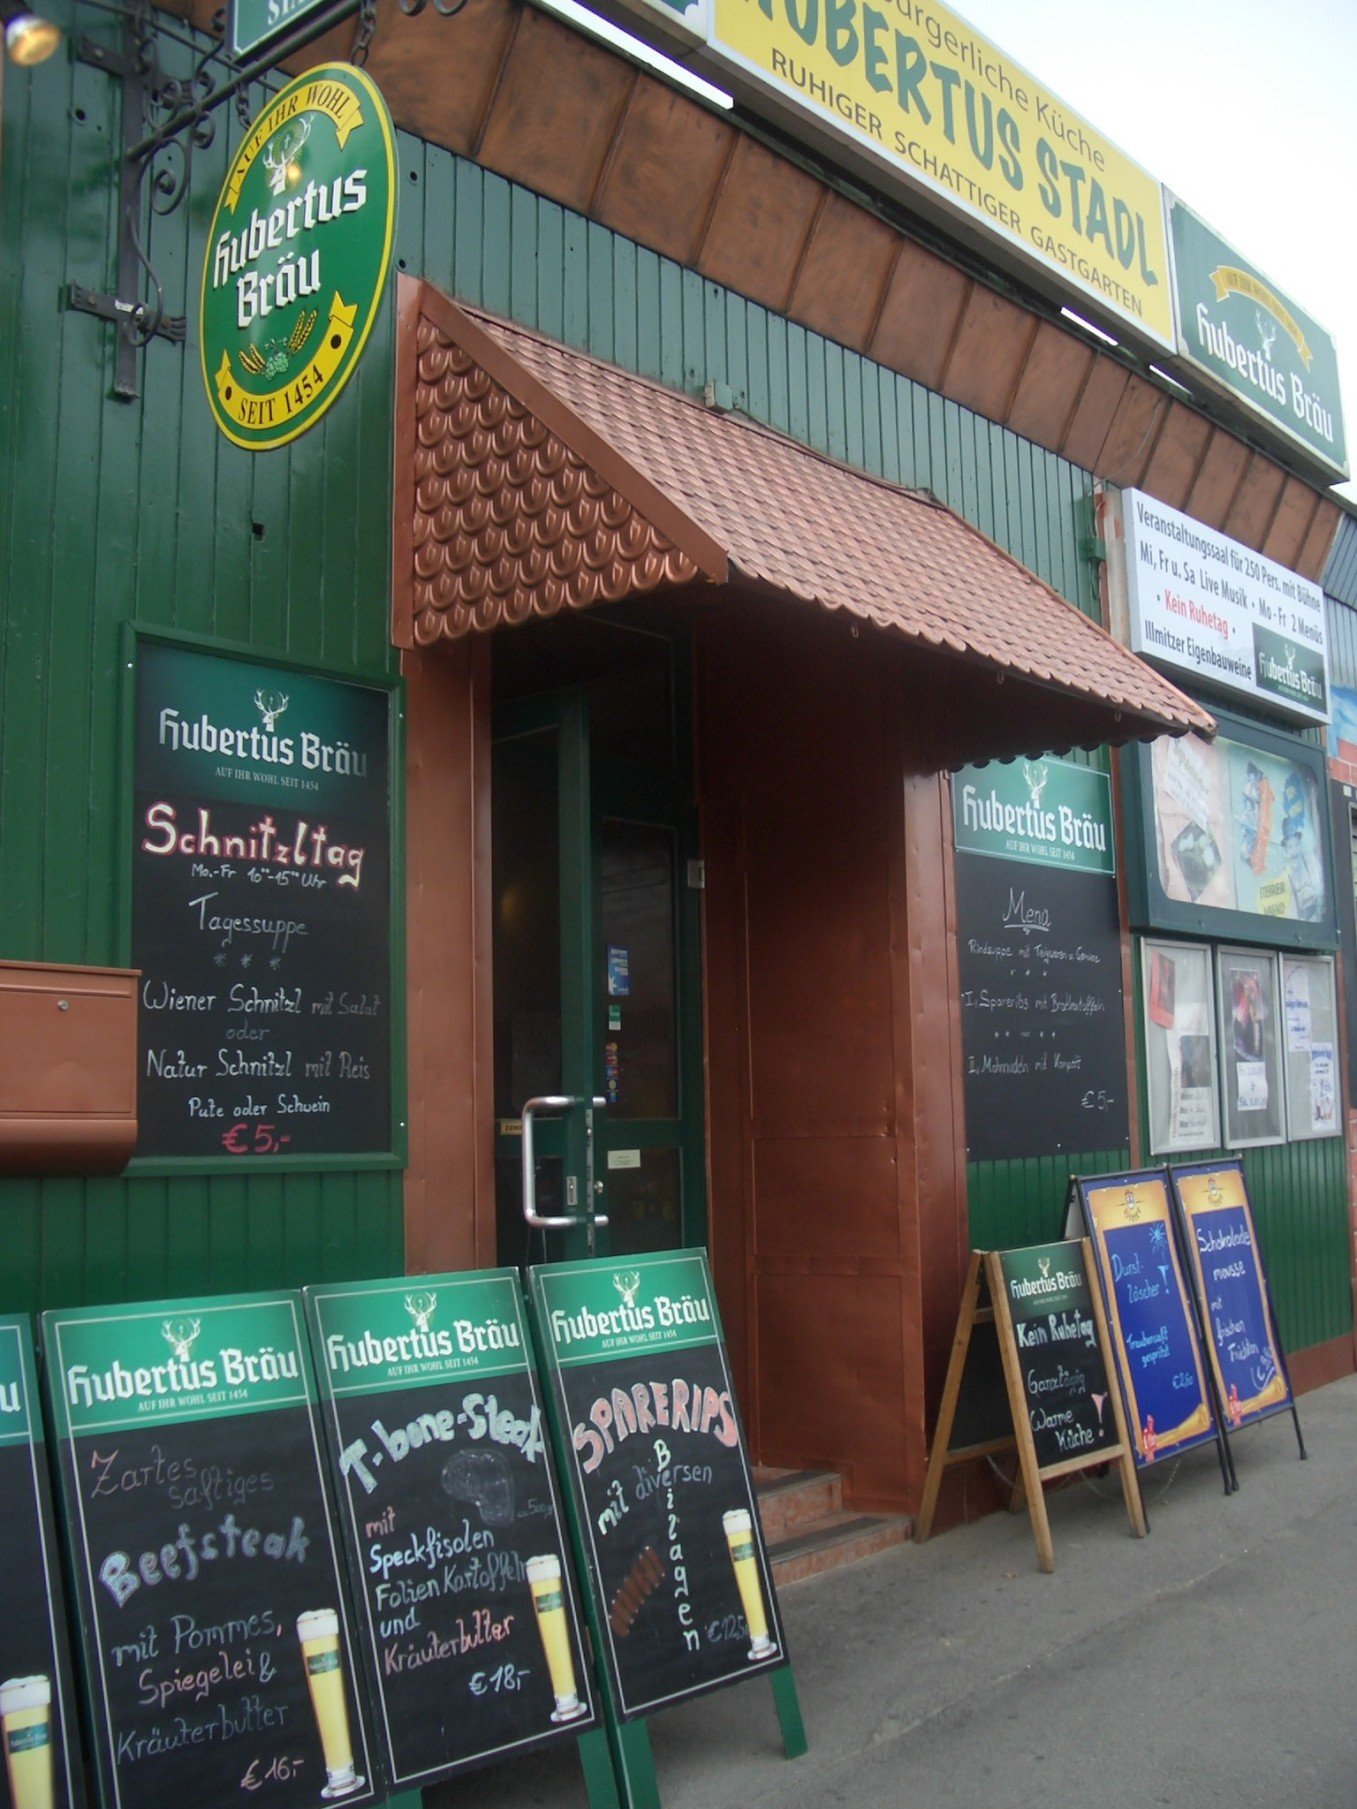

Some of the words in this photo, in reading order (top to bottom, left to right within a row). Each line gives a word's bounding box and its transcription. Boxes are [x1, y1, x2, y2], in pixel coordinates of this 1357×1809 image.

[268, 95, 299, 132] IHR
[306, 83, 351, 119] WOHL
[1035, 96, 1105, 172] Küche
[745, 0, 1024, 192] UBERTUS
[1036, 137, 1158, 287] STADL
[772, 48, 882, 141] RUHIGER
[894, 131, 1021, 234] SCHATTIGER
[1031, 226, 1143, 318] GASTGARTEN
[213, 169, 368, 290] Hubertus
[236, 249, 321, 330] Bräu
[238, 397, 276, 424] SEIT
[283, 364, 324, 415] 1454
[1196, 303, 1287, 406] Hubertus
[1290, 372, 1334, 443] Bräu
[1137, 501, 1228, 565] Veranstaltungssaal
[1230, 549, 1244, 571] für
[1245, 556, 1260, 581] 250
[1262, 568, 1281, 592] Pers.
[1282, 582, 1296, 599] mit
[1297, 585, 1321, 613] Bühne
[1140, 540, 1156, 571] Mi,
[1159, 550, 1169, 570] Fr
[1184, 561, 1196, 585] Sa
[1200, 569, 1220, 596] Live
[1221, 580, 1249, 609] Musik
[1259, 597, 1272, 618] Mo
[1298, 615, 1323, 645] Menüs
[1165, 589, 1187, 617] Kein
[1189, 604, 1229, 640] Ruhetag
[1145, 619, 1185, 654] Illmitzer
[1187, 636, 1252, 681] Eigenbauweine
[158, 707, 294, 766] Hubertus
[300, 732, 368, 778] Bräu
[215, 766, 233, 778] AUF
[234, 769, 251, 781] IHR
[253, 771, 279, 786] WOHL
[280, 776, 300, 789] SEIT
[301, 779, 319, 791] 1454
[142, 801, 365, 891] Schnitzltag
[963, 784, 1057, 842] Hubertus
[1058, 805, 1107, 852] Bräu
[301, 872, 328, 889] Uhr
[189, 891, 309, 953] Tagessuppe
[143, 980, 217, 1012] Wiener
[227, 983, 302, 1015] Schnitzl
[311, 991, 333, 1015] mit
[225, 1021, 271, 1041] oder
[146, 1049, 208, 1079] Natur
[216, 1048, 292, 1077] Schnitzl
[305, 1051, 332, 1078] mit
[339, 1051, 371, 1080] Reis
[188, 1096, 225, 1118] Pute
[233, 1095, 267, 1118] oder
[277, 1093, 331, 1115] Schwein
[1010, 1275, 1057, 1300] Hubertus
[1056, 1271, 1083, 1293] Bräu
[327, 1329, 453, 1373] Hubertus
[453, 1318, 521, 1354] Bräu
[551, 1304, 655, 1344] Hubertus
[654, 1295, 711, 1327] Bräu
[1016, 1322, 1049, 1348] Kein
[1048, 1309, 1098, 1349] Ruhetag
[67, 1358, 217, 1408] Hubertus
[219, 1346, 299, 1385] Bräu
[387, 1366, 403, 1377] AUF
[403, 1364, 420, 1375] IHR
[420, 1361, 444, 1374] WOHL
[444, 1358, 461, 1370] SEIT
[462, 1356, 480, 1367] 1454
[138, 1400, 158, 1412] AUF
[158, 1398, 177, 1410] IHR
[178, 1395, 205, 1409] WOHL
[206, 1391, 227, 1405] SEIT
[228, 1389, 249, 1401] 1454
[1054, 1422, 1095, 1452] Küche
[91, 1444, 198, 1499] Zartes
[365, 1506, 396, 1539] mit
[597, 1479, 630, 1535] mit
[99, 1513, 311, 1609] Beefsteak
[369, 1519, 495, 1581] Speckfisolen
[375, 1574, 441, 1611] Folien
[111, 1625, 159, 1667] mit
[380, 1606, 421, 1639] und
[384, 1607, 516, 1676] Kräuterbutter
[138, 1651, 256, 1709] Spiegelei
[116, 1694, 289, 1766] Kräuterbutter
